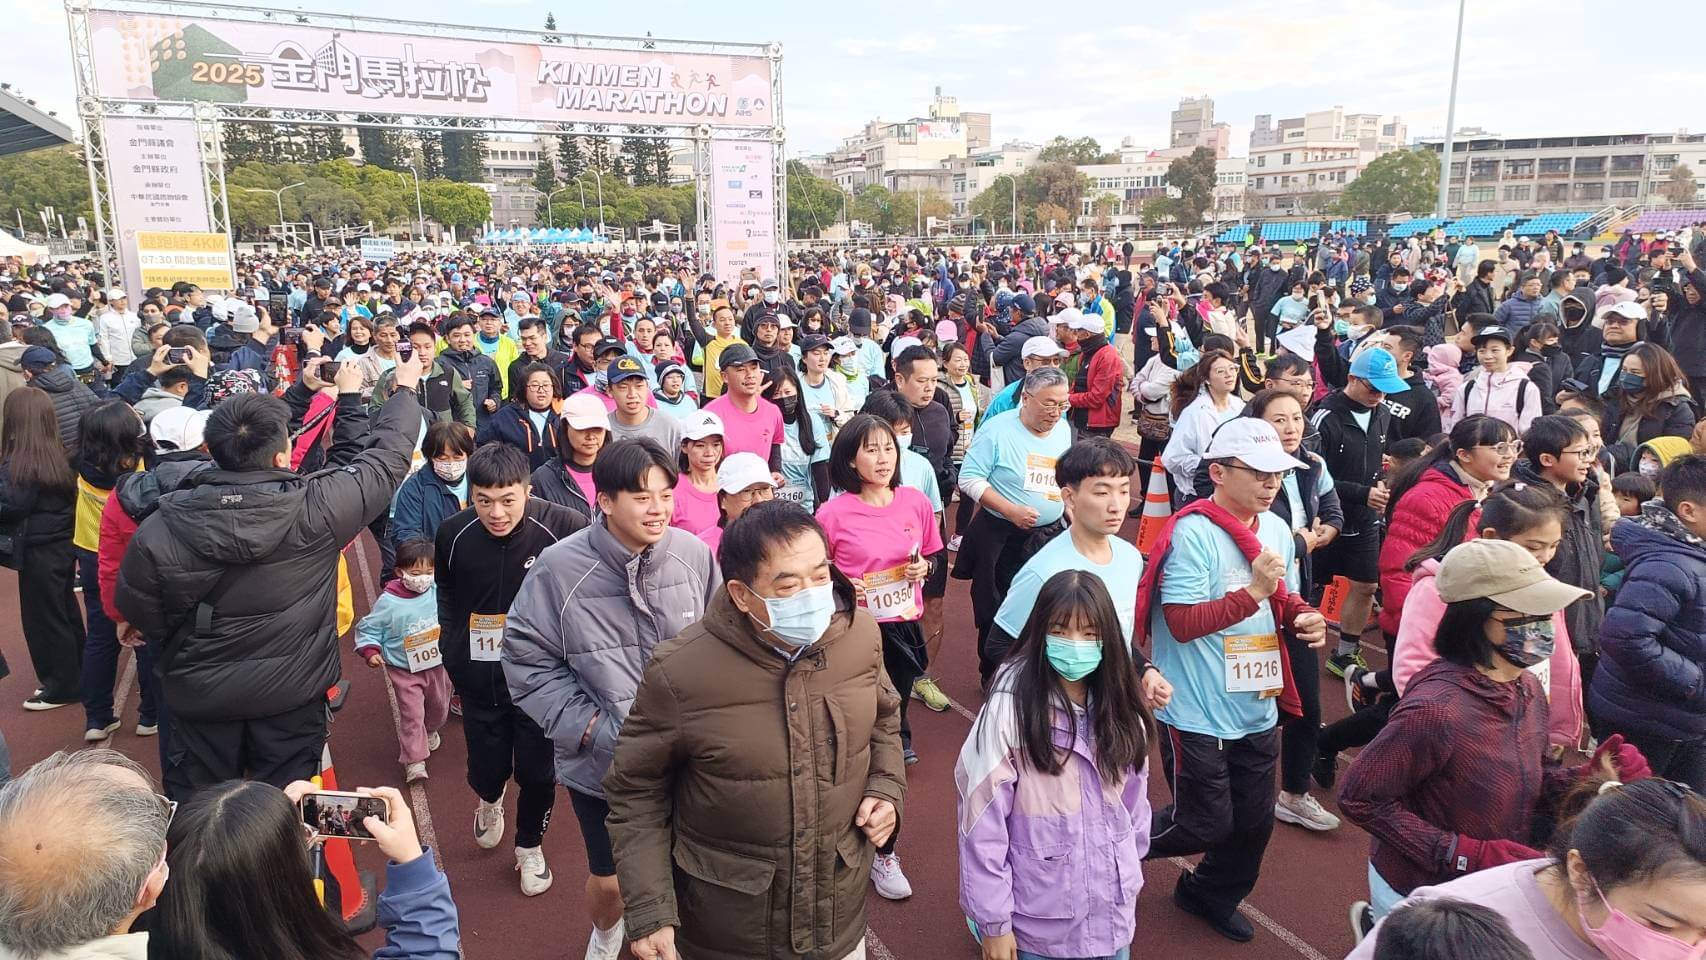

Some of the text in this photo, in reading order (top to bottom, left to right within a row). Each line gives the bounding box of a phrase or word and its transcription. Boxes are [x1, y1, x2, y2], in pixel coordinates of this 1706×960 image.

[192, 61, 264, 87] 2025
[252, 36, 491, 103] 金門馬拉松
[537, 60, 663, 88] KINMEN
[556, 86, 728, 117] MARATHON
[129, 138, 174, 147] 金門縣議會
[133, 164, 178, 174] 金門縣政府
[193, 238, 224, 249] 4KM
[141, 255, 172, 264] 07:30
[1029, 471, 1058, 488] 1010
[872, 588, 912, 609] 10350
[413, 647, 439, 664] 109
[1232, 660, 1278, 679] 11216
